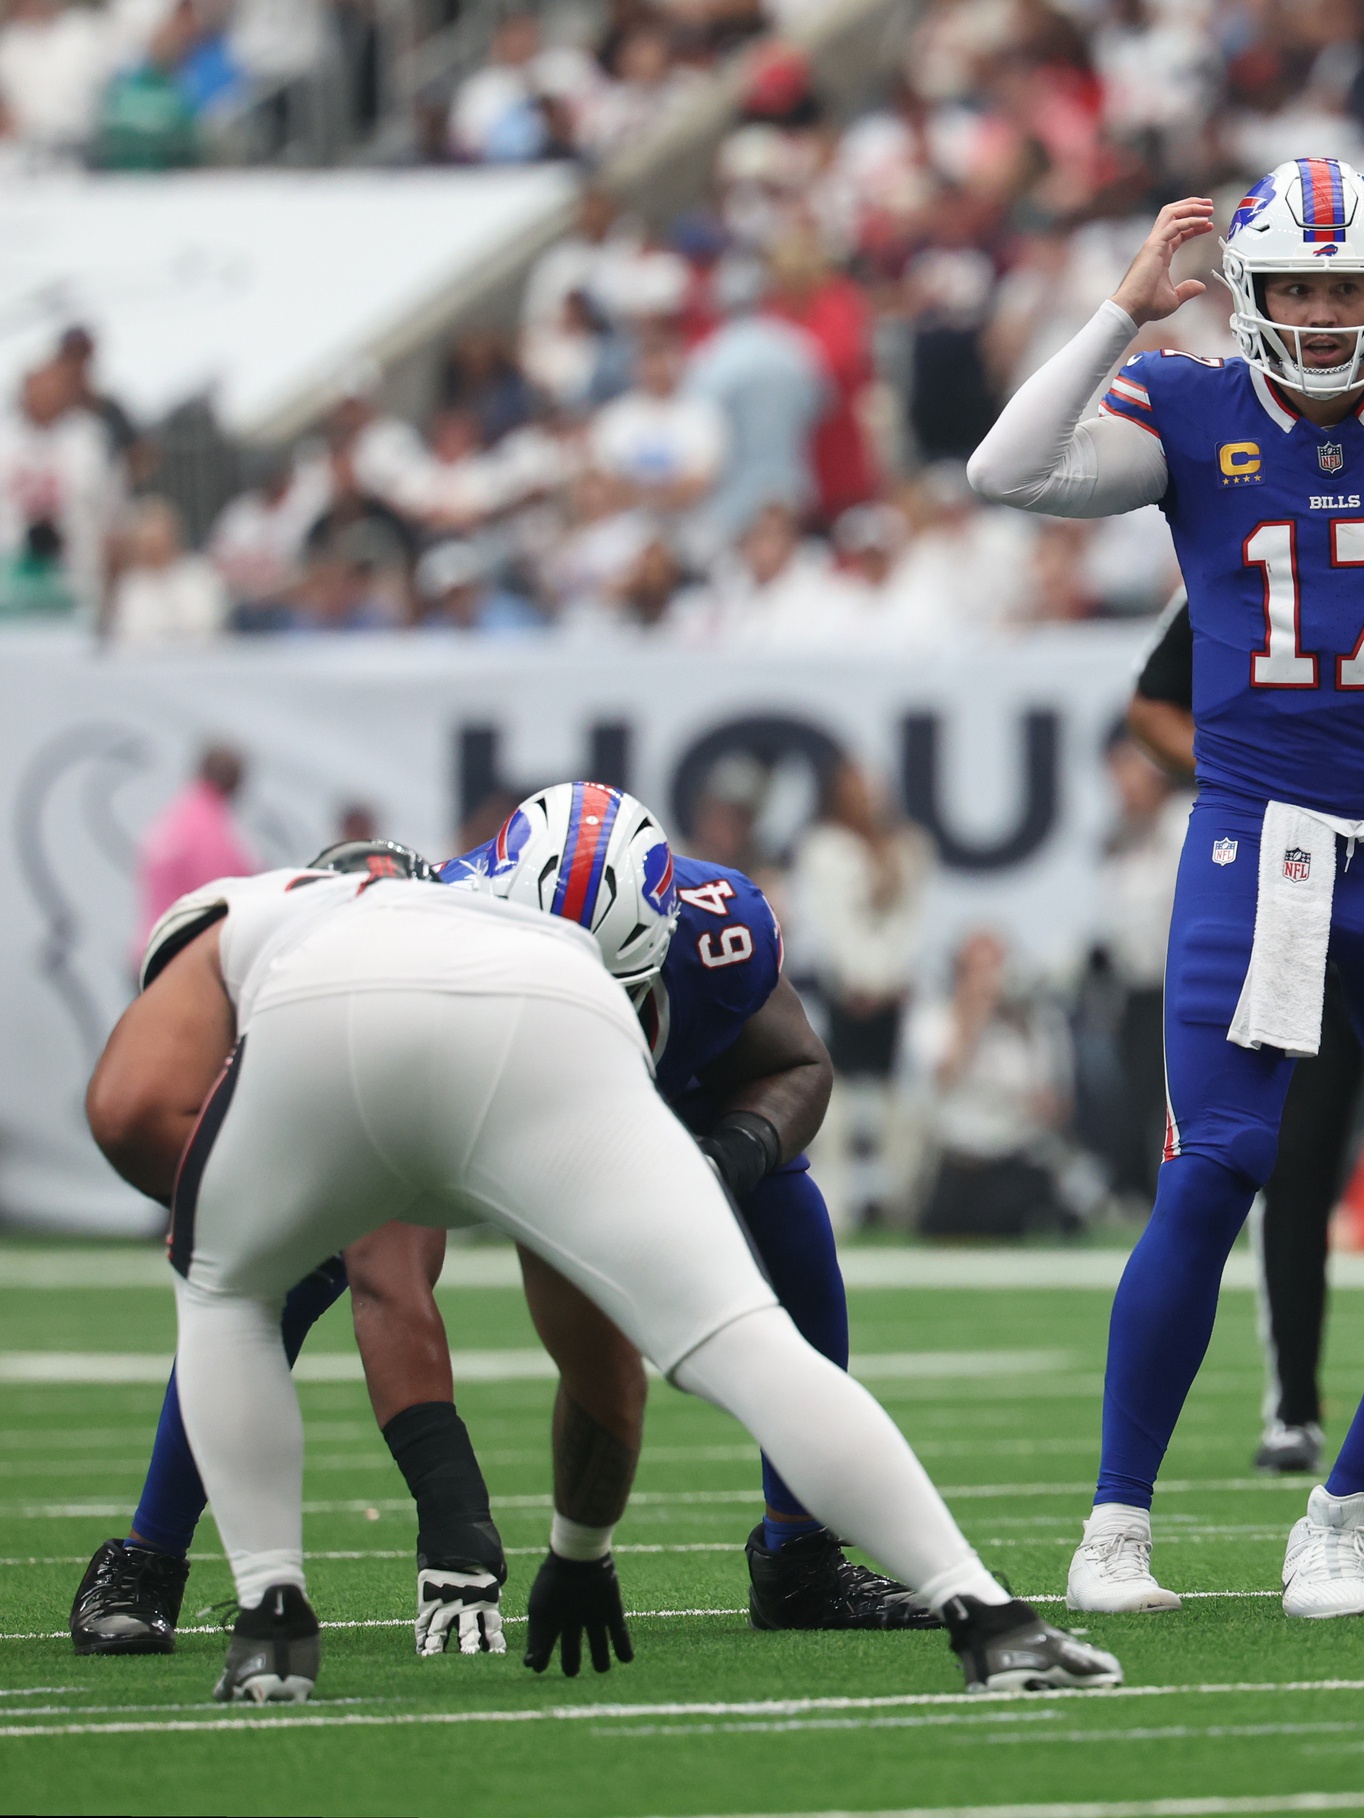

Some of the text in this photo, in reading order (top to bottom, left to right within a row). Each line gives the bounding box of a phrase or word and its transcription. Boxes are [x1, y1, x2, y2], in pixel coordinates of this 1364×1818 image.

[1219, 441, 1261, 476] C
[1309, 494, 1361, 509] BILLS
[677, 878, 756, 970] 64
